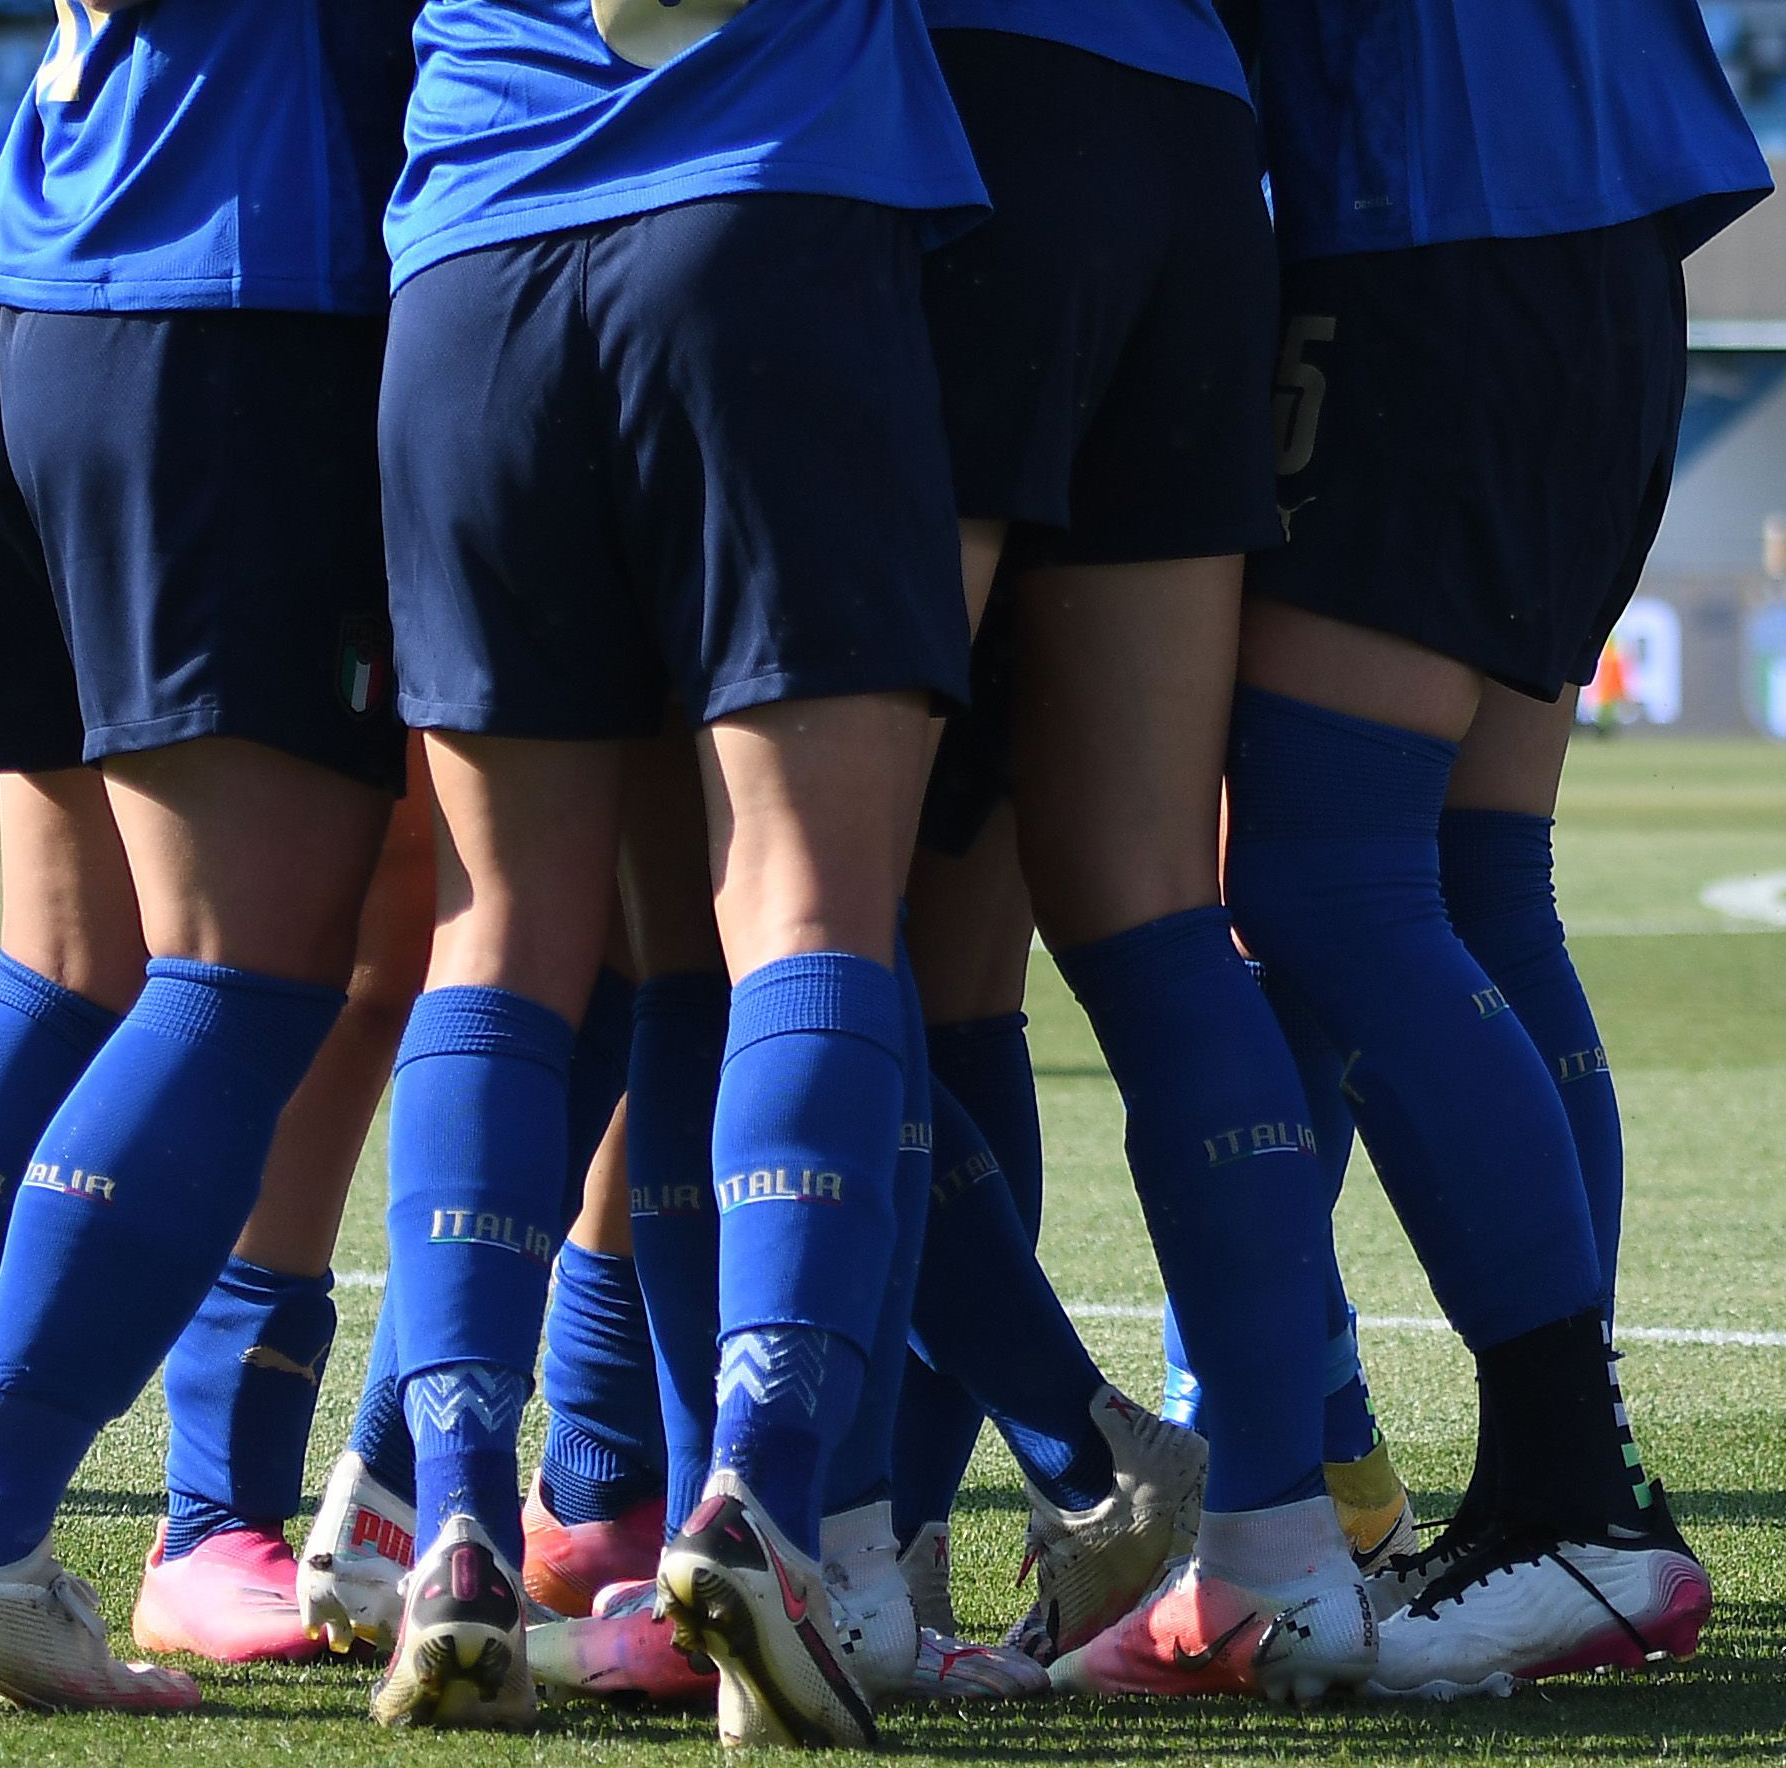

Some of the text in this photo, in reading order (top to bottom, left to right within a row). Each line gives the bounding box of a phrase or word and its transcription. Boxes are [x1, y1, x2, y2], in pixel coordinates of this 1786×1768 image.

[1203, 1121, 1318, 1163] ITALIA
[630, 1183, 701, 1211] ALIA
[717, 1168, 842, 1211] ITALIA
[431, 1208, 552, 1264] ITALIA
[350, 1508, 416, 1568] PUM
